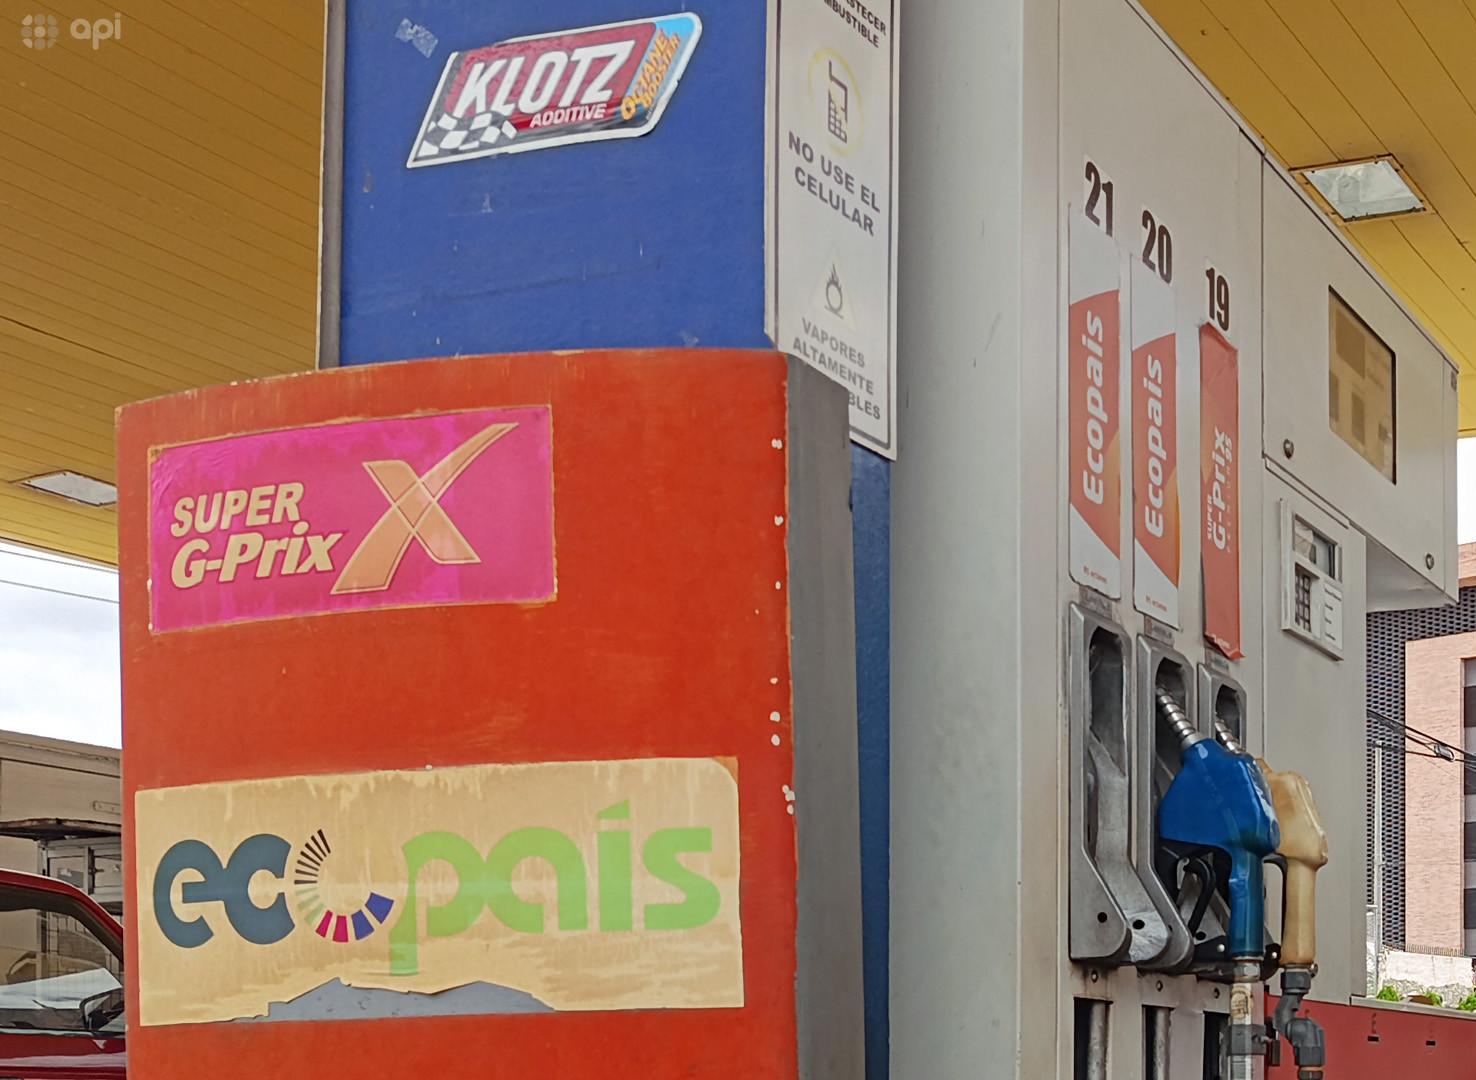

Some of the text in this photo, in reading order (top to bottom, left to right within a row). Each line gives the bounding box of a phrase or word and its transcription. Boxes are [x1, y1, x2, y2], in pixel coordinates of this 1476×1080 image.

[846, 0, 887, 36] STECER
[453, 39, 636, 119] KLOTZ
[529, 103, 608, 129] ADDITIVE
[788, 130, 881, 213] NO USE EL
[794, 166, 874, 236] CELULAR
[1085, 161, 1114, 238] 21
[1142, 210, 1173, 284] 20
[1205, 267, 1230, 332] 19
[792, 336, 875, 396] ALTAMENTE
[801, 317, 866, 369] VAPORES
[1082, 310, 1108, 505] Ecopais
[1143, 354, 1168, 539] Ecopais
[171, 482, 304, 538] SUPER
[1212, 424, 1227, 551] G-Prix
[170, 521, 343, 590] G-Prix
